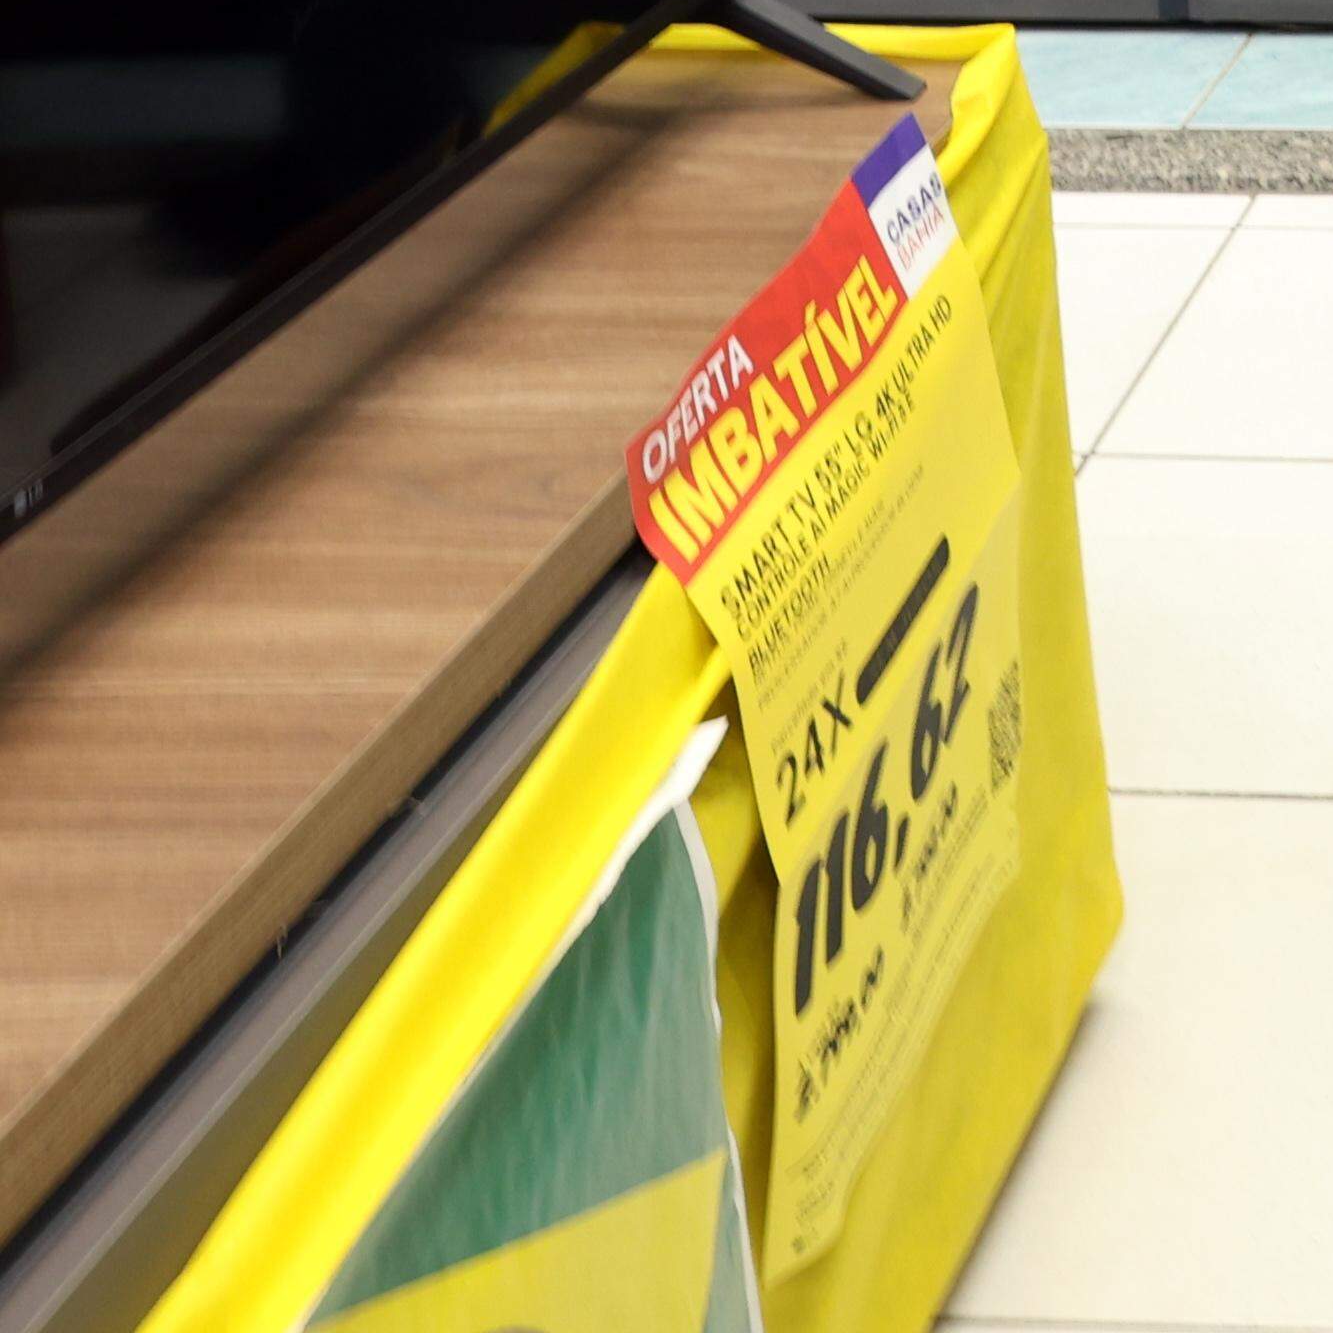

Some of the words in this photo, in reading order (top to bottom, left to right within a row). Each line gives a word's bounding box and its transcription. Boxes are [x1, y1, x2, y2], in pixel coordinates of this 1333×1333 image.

[887, 171, 941, 245] CASAS
[642, 334, 755, 485] OFERTA
[648, 255, 898, 566] IMBATÍVEL
[721, 515, 793, 617] SMART
[786, 479, 818, 529] TV
[843, 411, 873, 459] LG
[891, 323, 936, 395] ULTRA
[929, 294, 952, 333] HD
[736, 533, 812, 642] CONTROLE
[825, 457, 871, 523] MAGIC
[777, 669, 853, 829] 24X
[794, 580, 978, 1018] 116,62
